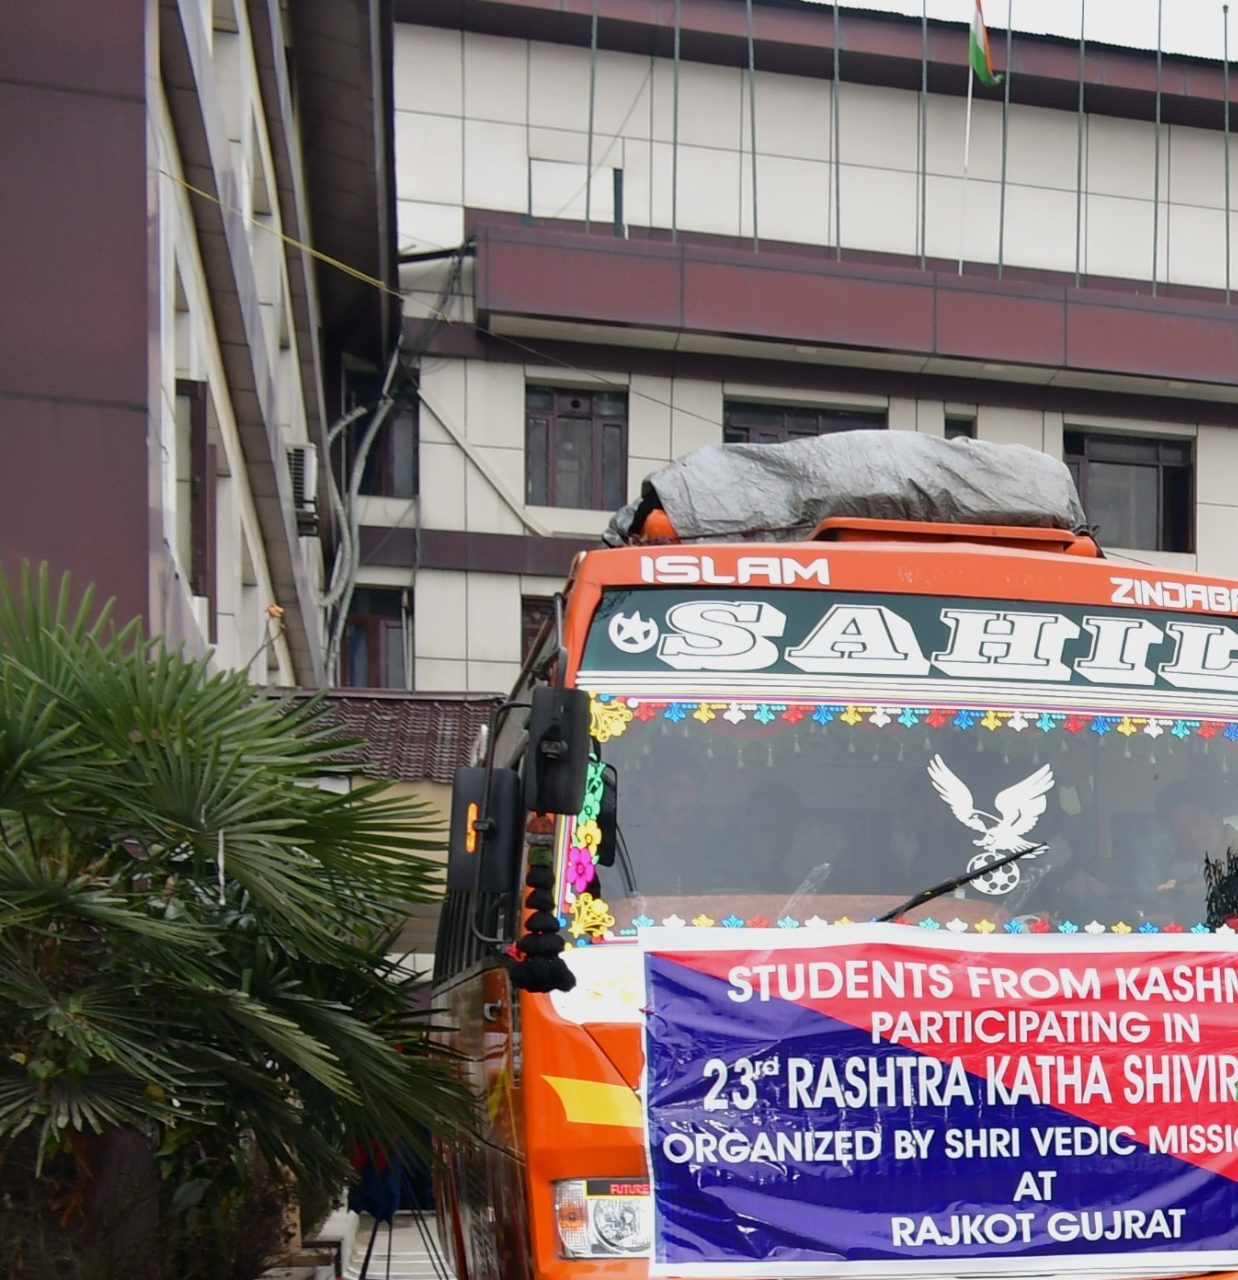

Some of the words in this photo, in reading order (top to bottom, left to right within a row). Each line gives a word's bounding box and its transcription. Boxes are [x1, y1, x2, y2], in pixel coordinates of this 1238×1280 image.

[640, 555, 831, 585] ISLAM
[727, 961, 954, 1003] STUDENTS
[967, 966, 1101, 1001] FROM
[871, 1010, 1151, 1044] PARTICIPATING
[1163, 1012, 1200, 1043] IN
[702, 1055, 780, 1110] 23rd
[787, 1056, 975, 1110] RASHTRA
[986, 1054, 1113, 1106] KATHA
[663, 1129, 882, 1164] ORGANIZED
[894, 1128, 936, 1160] BY
[945, 1126, 1020, 1159] SHRI
[1031, 1125, 1137, 1158] VEDIC
[610, 1183, 650, 1195] FUTURE
[1013, 1170, 1057, 1202] AT
[891, 1212, 1036, 1247] RAJKOT
[1047, 1208, 1187, 1242] GUJRAT
